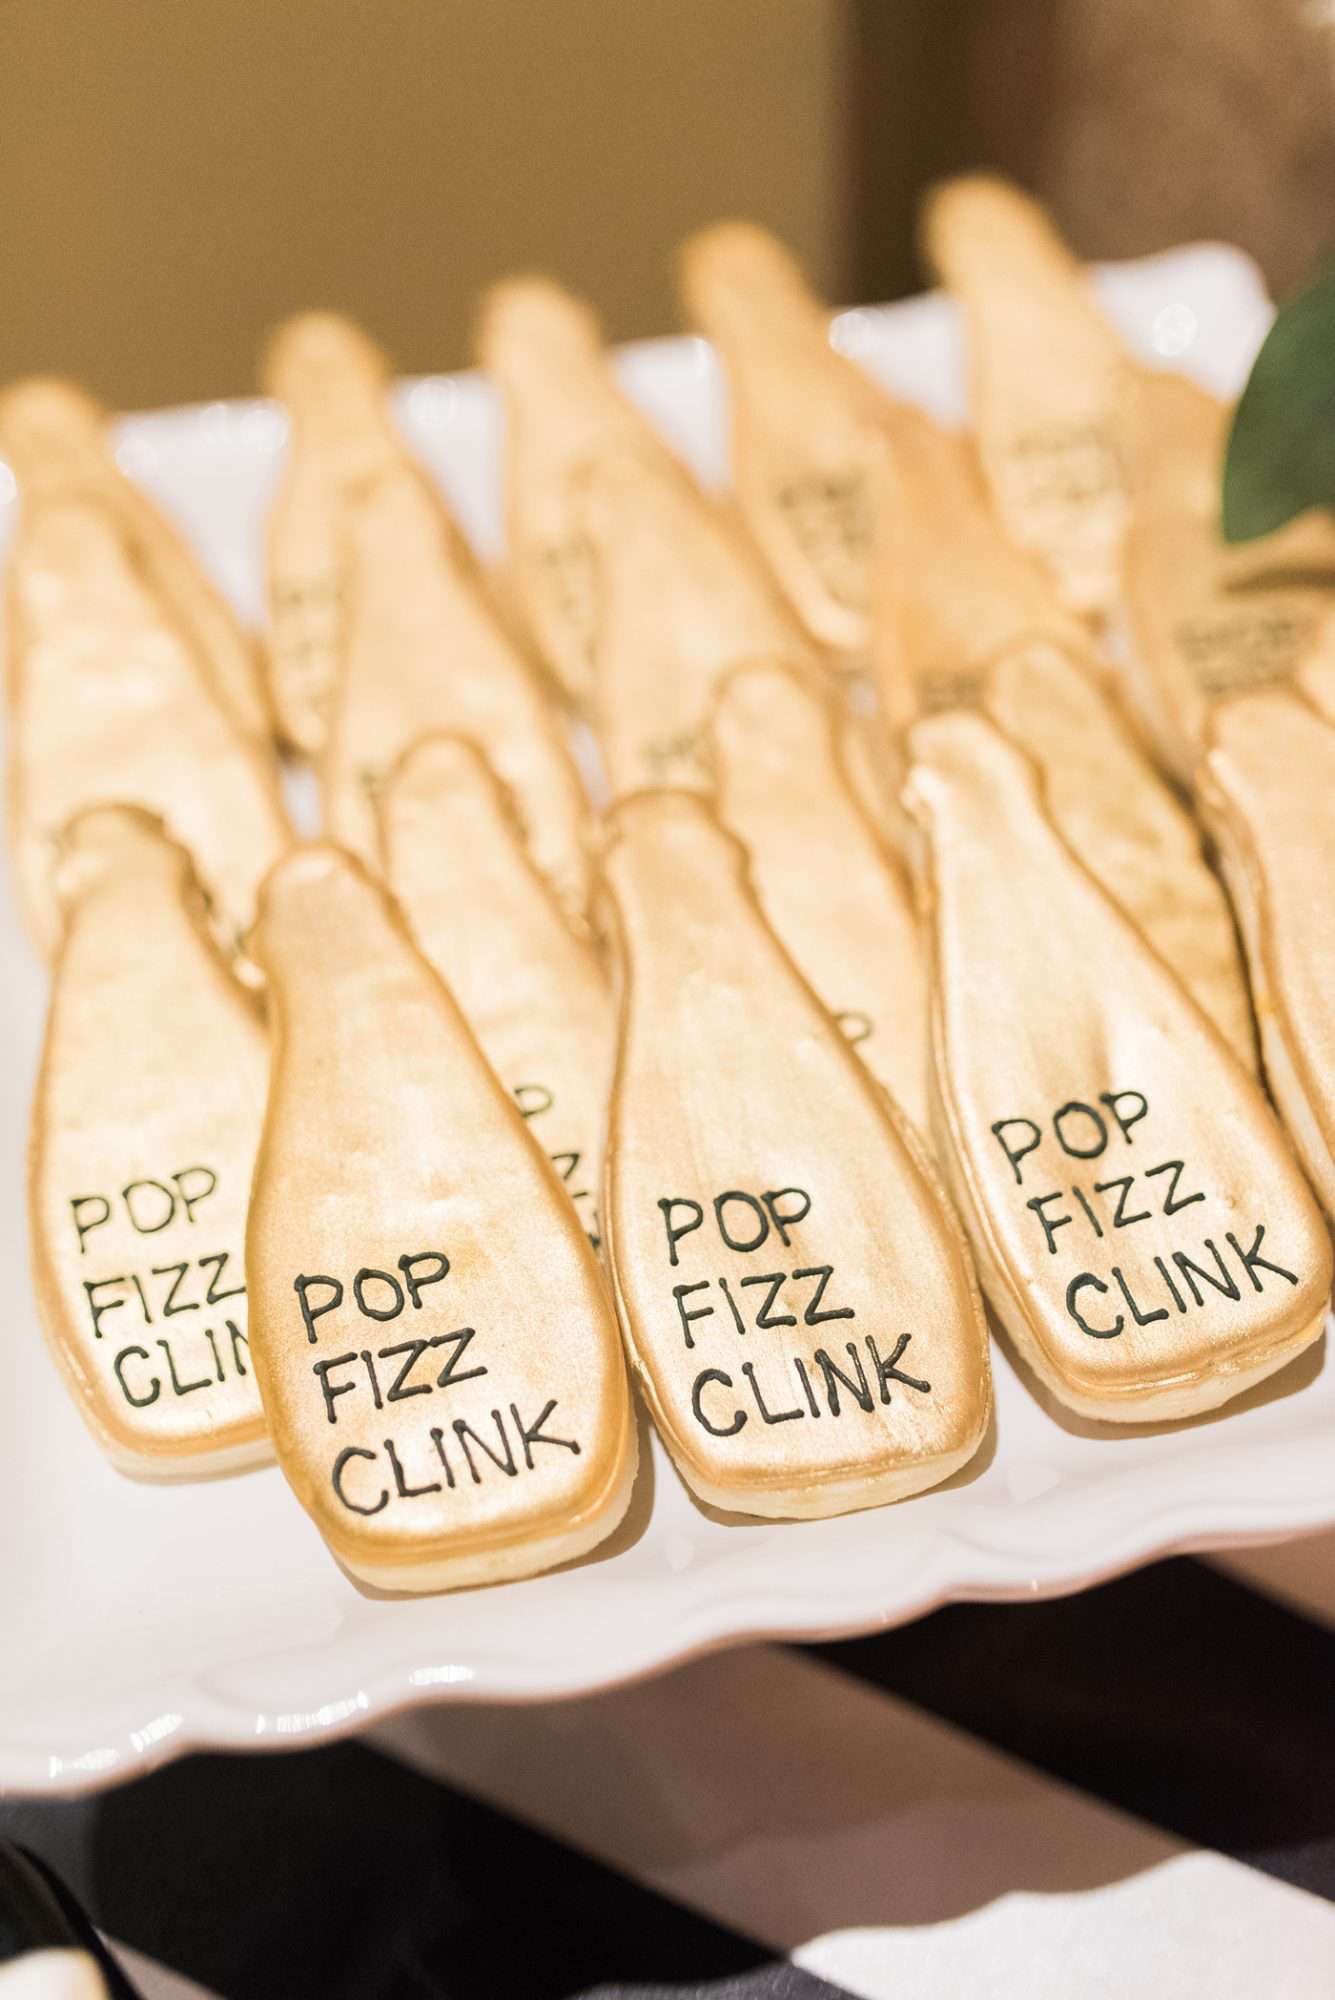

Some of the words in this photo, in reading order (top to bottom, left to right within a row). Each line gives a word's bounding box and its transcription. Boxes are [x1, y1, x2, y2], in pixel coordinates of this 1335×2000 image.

[992, 1091, 1149, 1184] POP
[71, 1167, 216, 1253] POP
[658, 1187, 812, 1266] POP
[1027, 1161, 1206, 1254] FIZZ
[83, 1252, 246, 1338] FIZZ
[294, 1251, 450, 1344] POP
[672, 1265, 855, 1348] FIZZ
[1066, 1225, 1299, 1339] CLINK
[113, 1320, 249, 1407] CLIN
[313, 1327, 488, 1424] FIZZ
[692, 1333, 931, 1437] CLINK
[332, 1400, 580, 1515] CLINK
